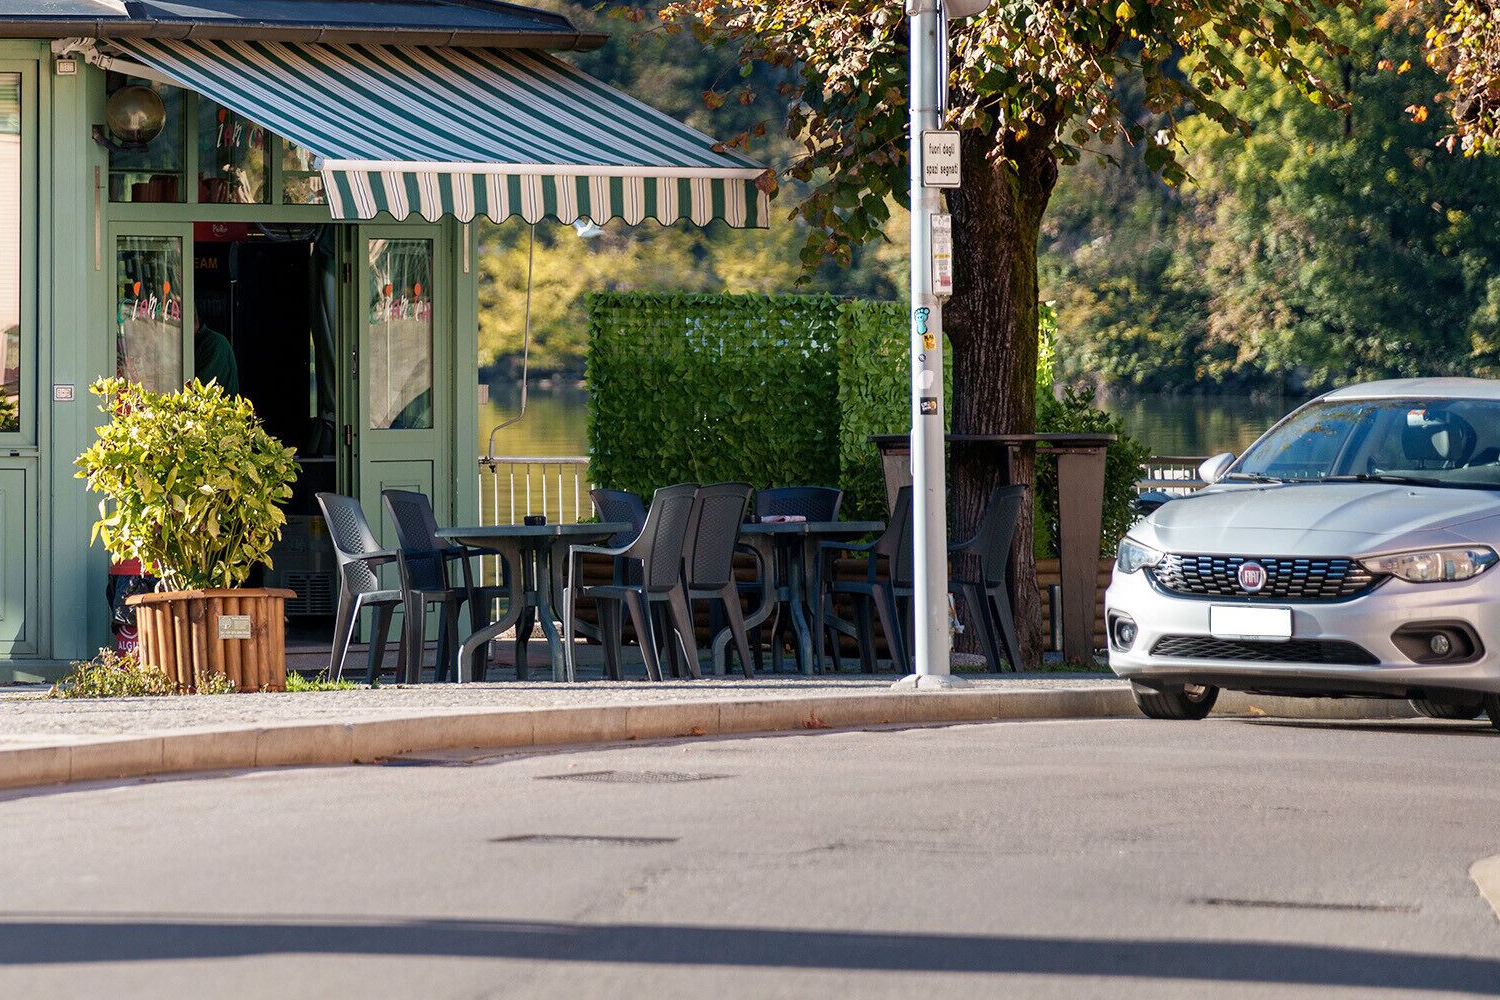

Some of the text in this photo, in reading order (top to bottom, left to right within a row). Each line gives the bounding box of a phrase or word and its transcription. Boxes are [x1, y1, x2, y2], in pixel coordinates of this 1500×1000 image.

[929, 143, 955, 157] fuori dagli
[927, 163, 959, 176] spazi segnati
